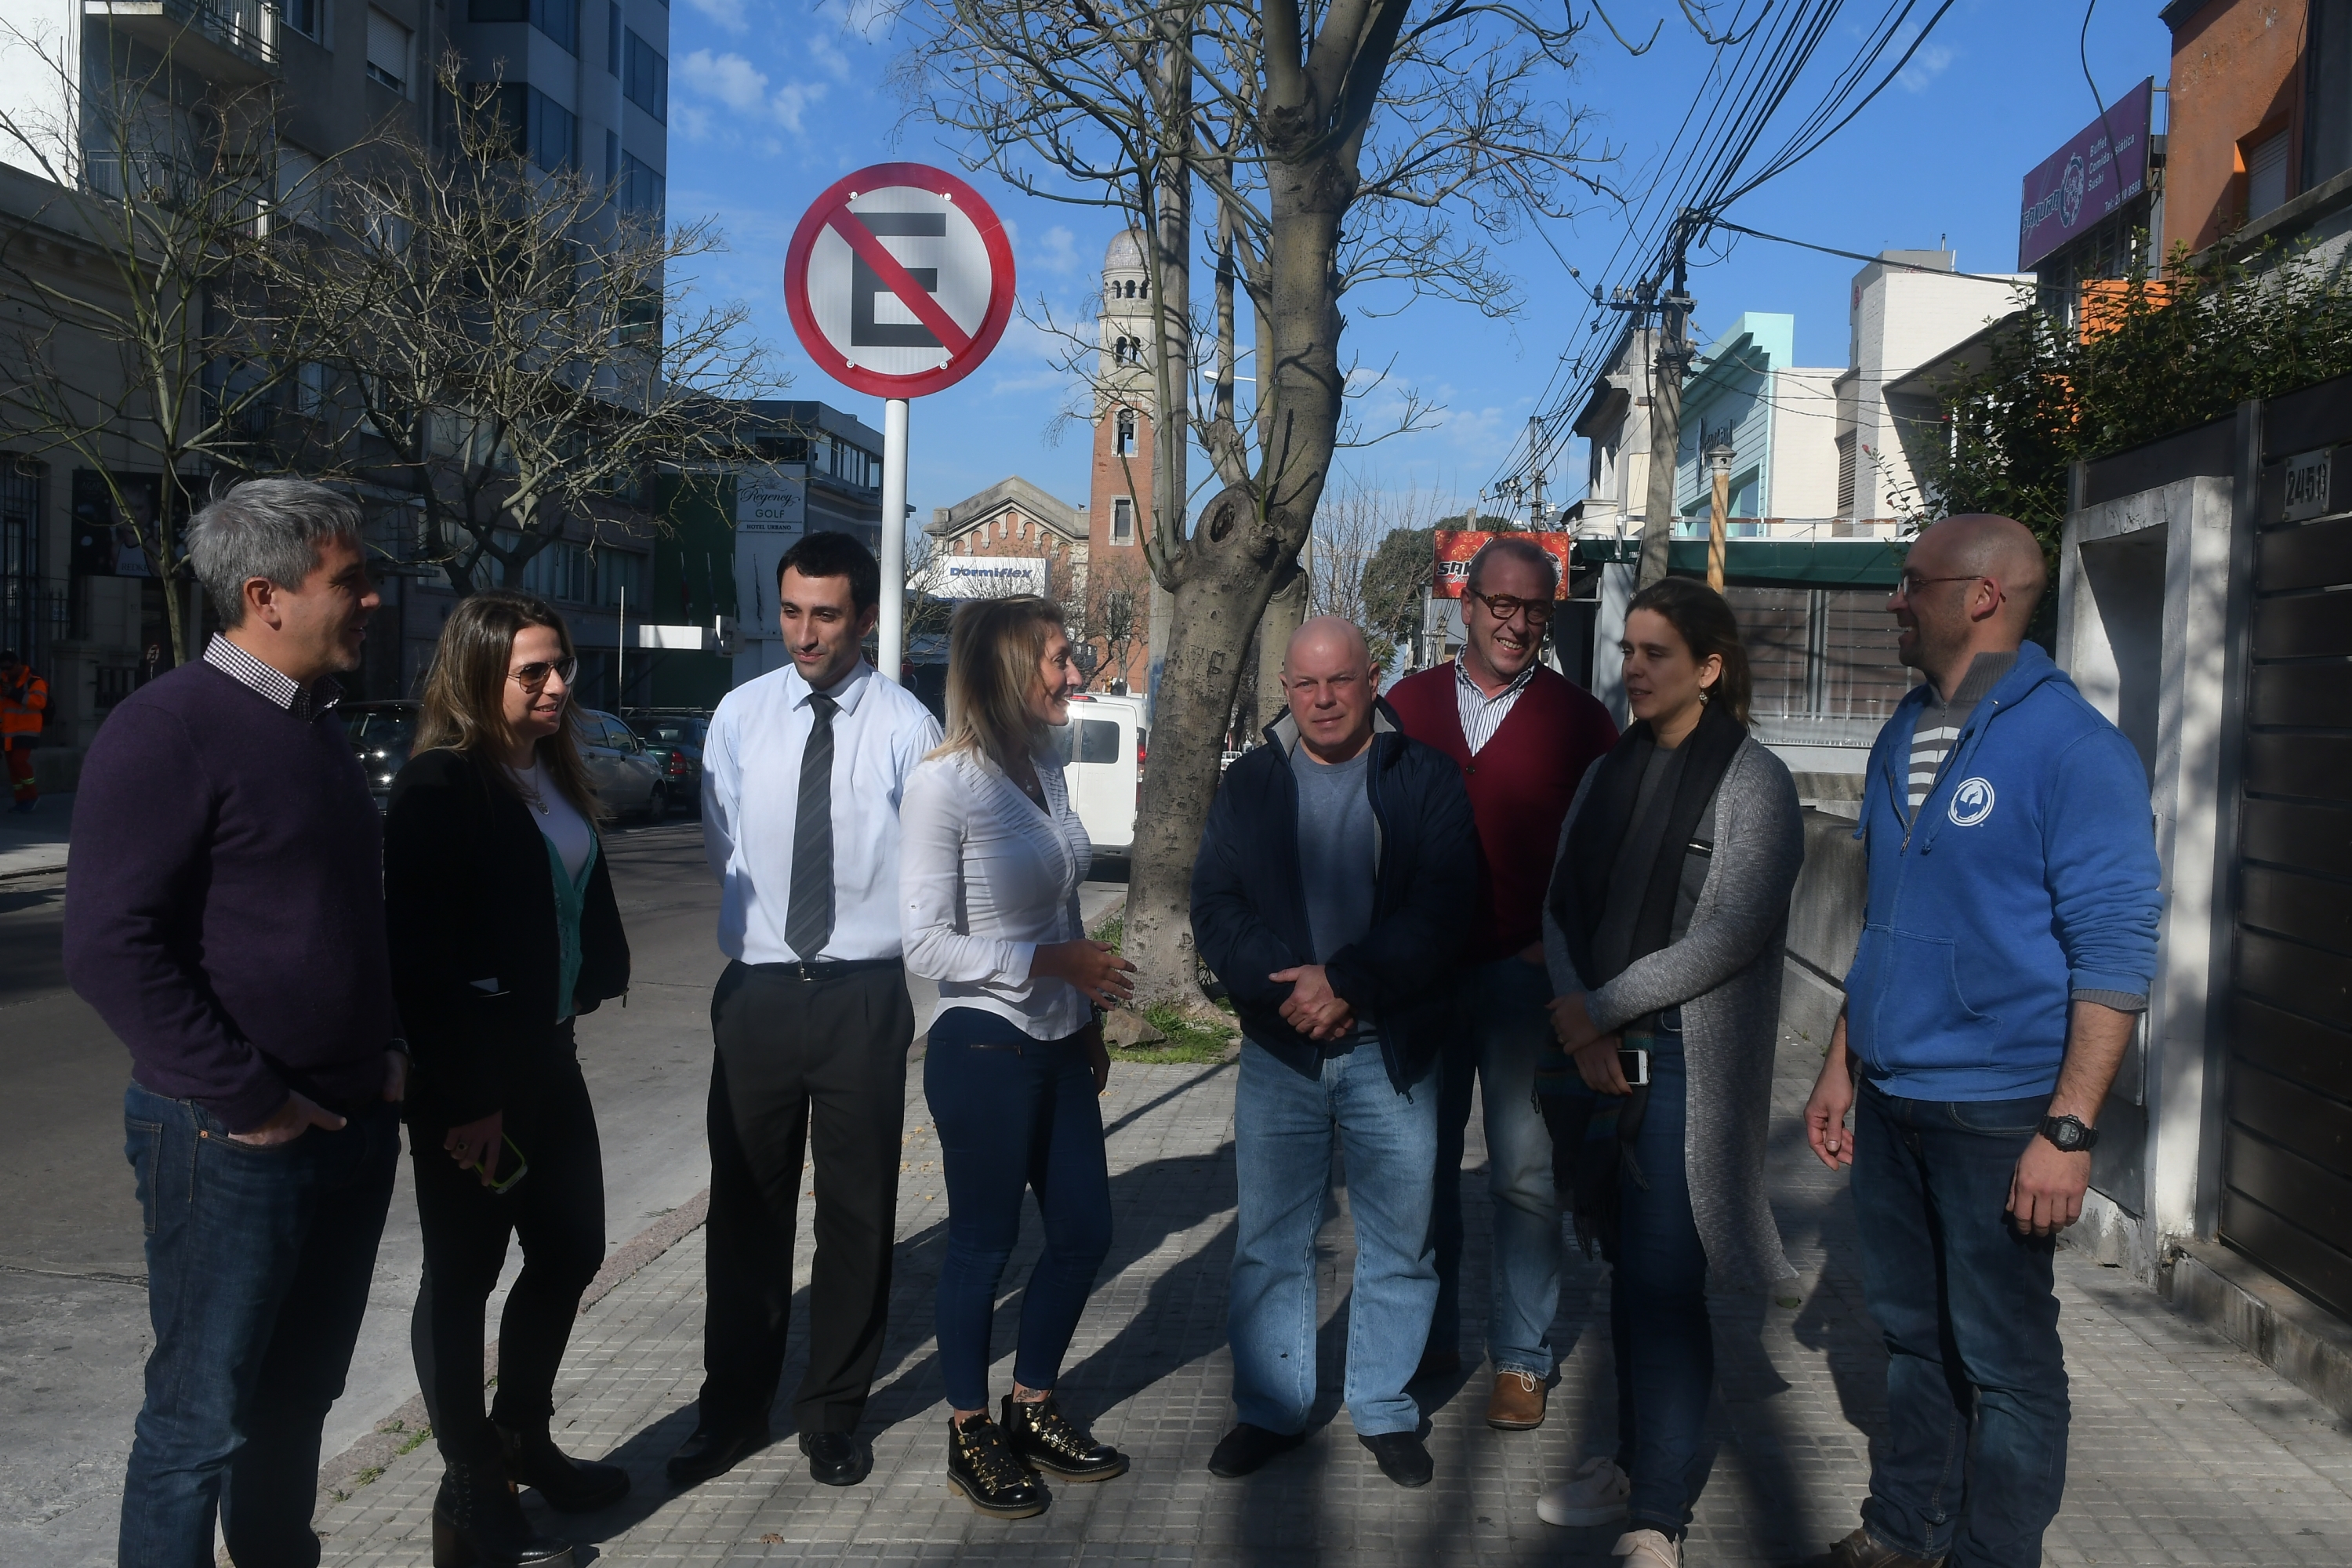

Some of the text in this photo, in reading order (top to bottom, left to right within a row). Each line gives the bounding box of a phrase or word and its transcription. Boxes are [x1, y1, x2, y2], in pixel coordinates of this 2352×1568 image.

[2089, 135, 2107, 158] Buffet
[2089, 133, 2135, 175] Comida siática
[2088, 170, 2104, 192] Sushi
[2021, 188, 2060, 234] SAKURA
[2104, 198, 2114, 212] Tel:
[851, 212, 947, 347] E
[2285, 463, 2327, 506] 2458
[739, 486, 800, 508] Regency
[755, 509, 785, 518] GOLF
[949, 567, 1033, 578] Dormiflex
[1436, 560, 1470, 577] SAK
